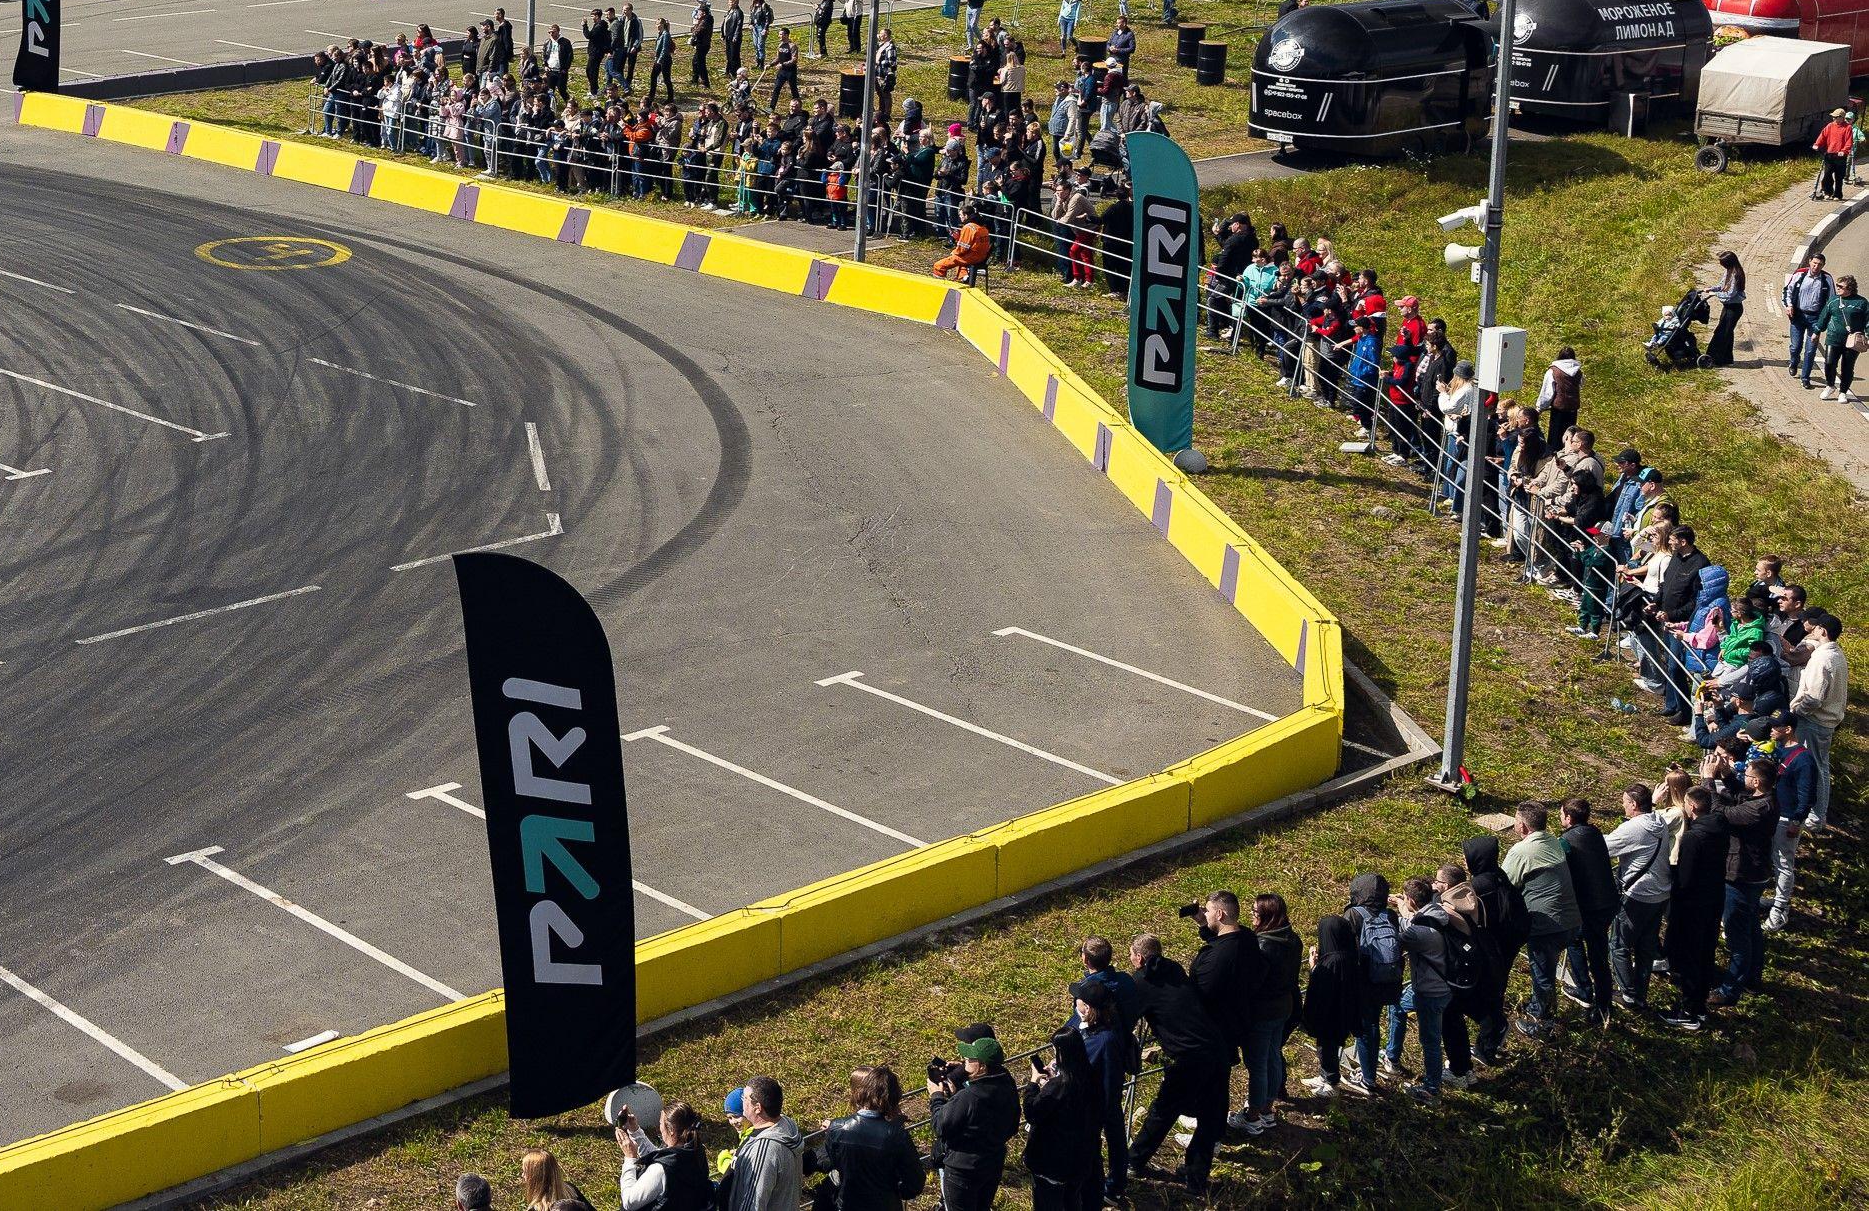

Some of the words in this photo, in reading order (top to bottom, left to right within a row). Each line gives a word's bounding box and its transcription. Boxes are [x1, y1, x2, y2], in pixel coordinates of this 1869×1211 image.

[1597, 2, 1676, 21] МОРОЖЕНОЕ
[1615, 20, 1675, 40] ЛИМОНАД
[1264, 108, 1303, 120] spacebox
[1142, 203, 1187, 386] PARI
[502, 677, 603, 985] PARI
